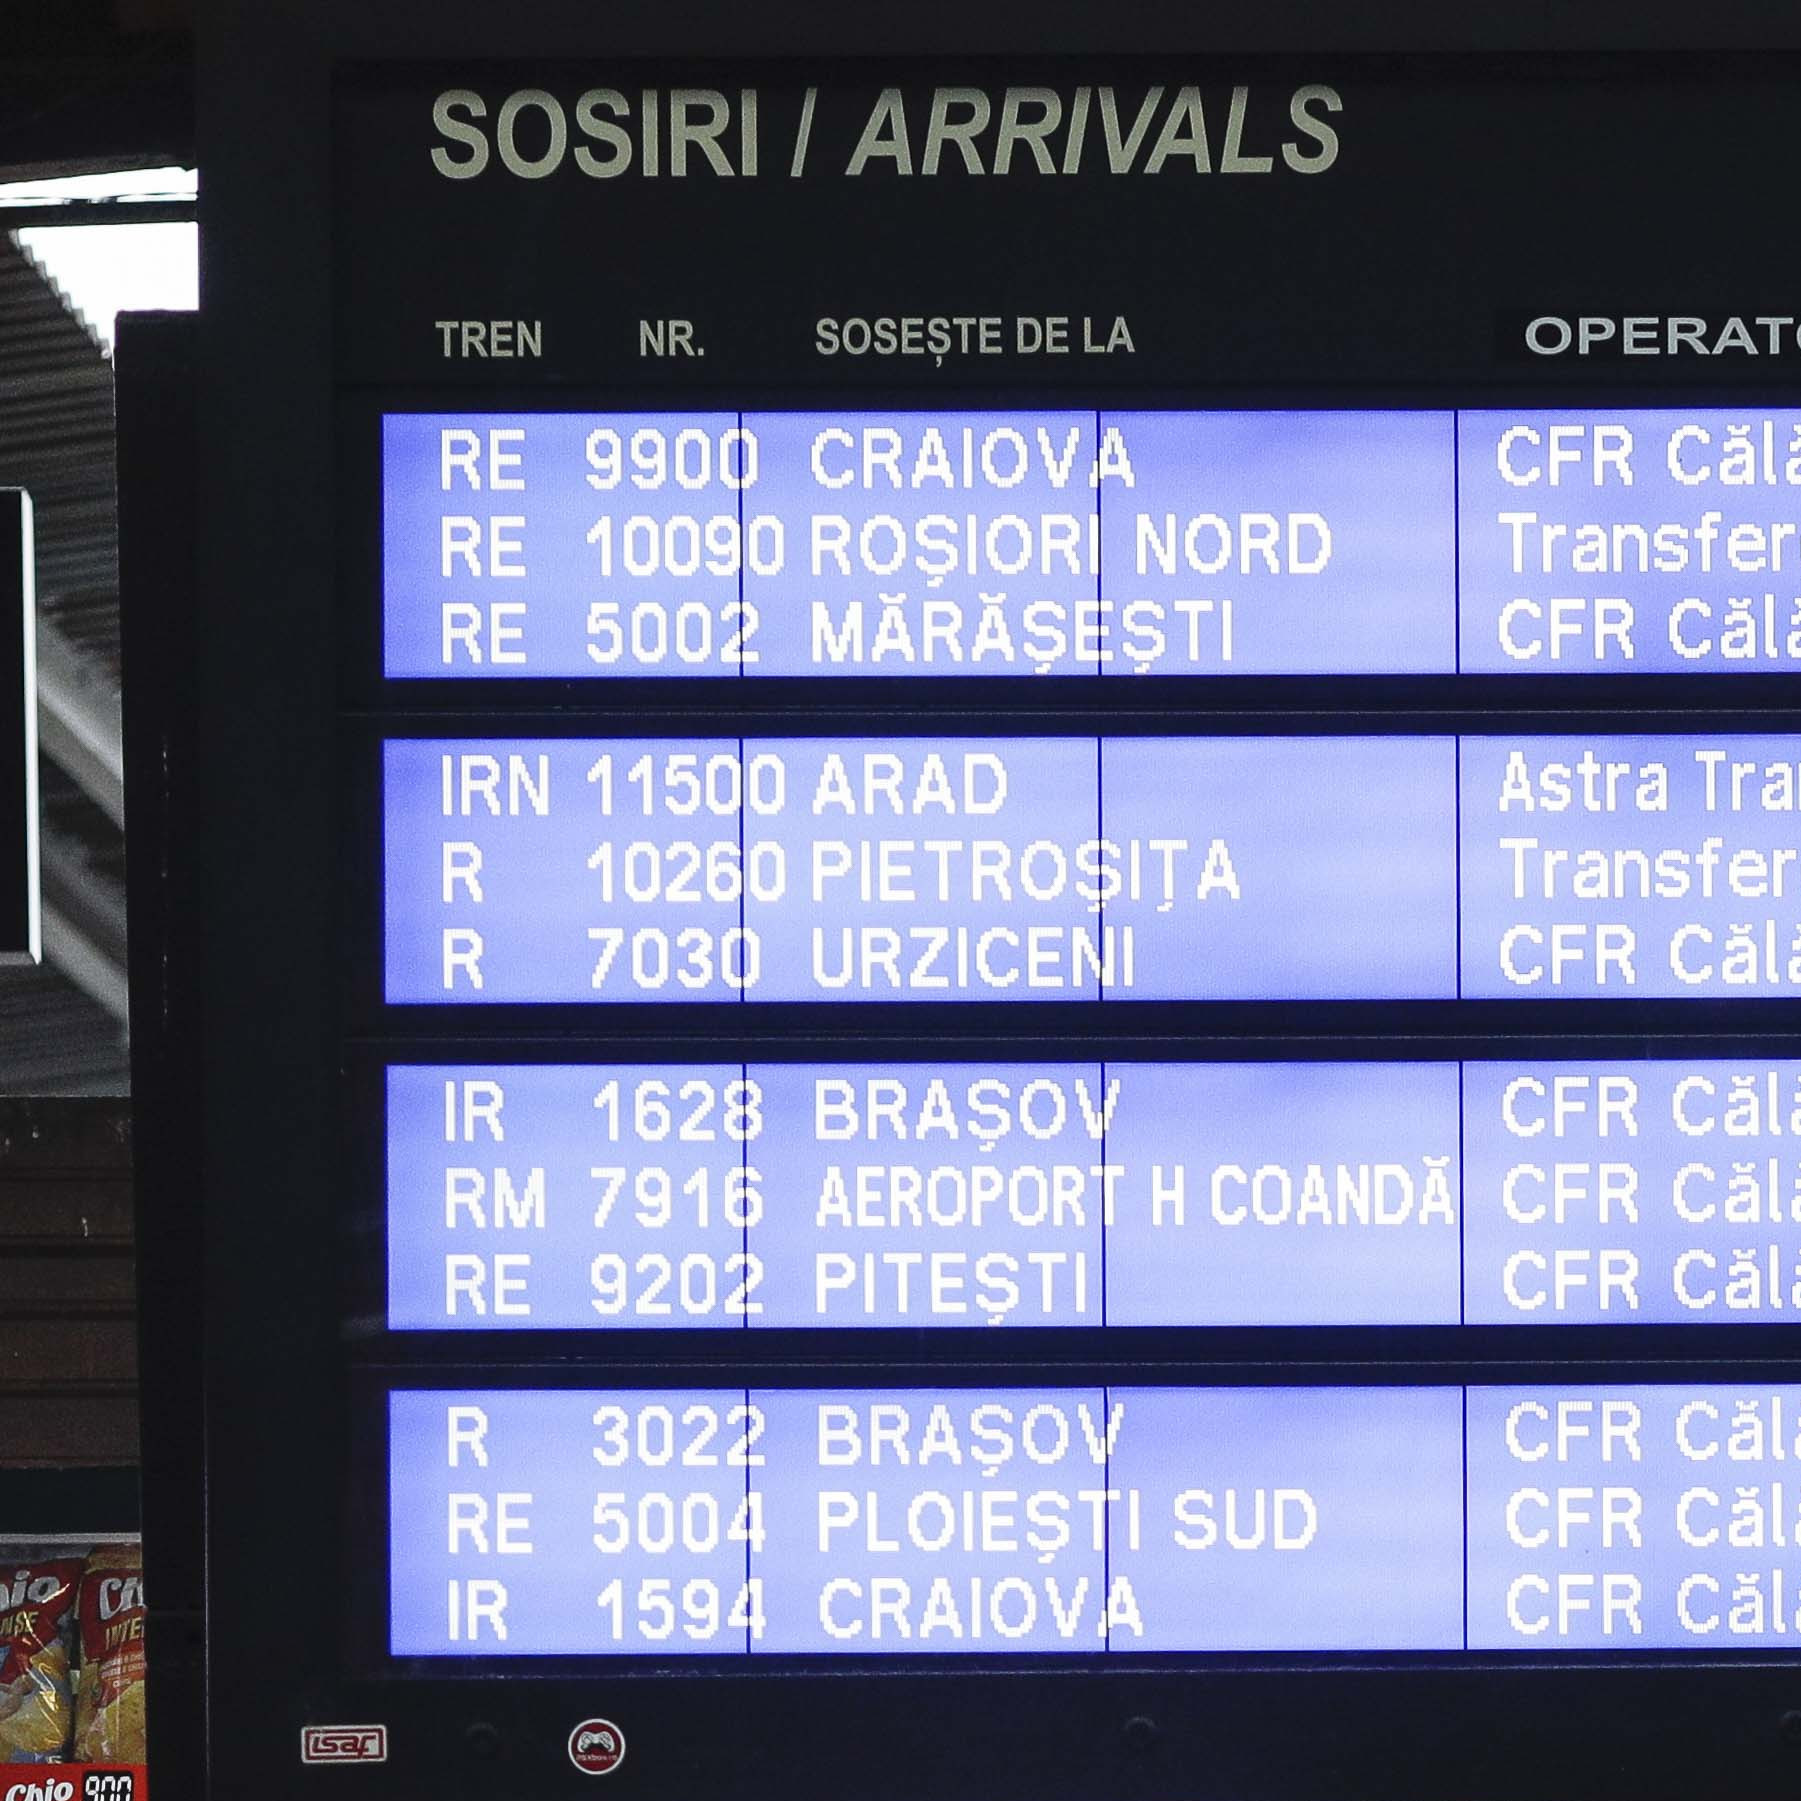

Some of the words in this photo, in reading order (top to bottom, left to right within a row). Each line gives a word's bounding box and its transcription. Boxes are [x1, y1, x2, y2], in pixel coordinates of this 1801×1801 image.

[431, 91, 757, 179] SOSIRI
[791, 90, 816, 177] /
[845, 88, 1343, 175] ARRIVALS
[435, 321, 541, 357] TREN
[639, 320, 705, 357] NR.
[816, 317, 1002, 367] SOSEȘTE
[1017, 317, 1069, 354] DE
[1084, 316, 1135, 353] LA
[442, 430, 524, 489] RE
[587, 429, 757, 489] 9900
[812, 428, 1134, 488] CRAIOVA
[1498, 426, 1632, 485] CFR
[443, 517, 525, 576] RE
[587, 516, 783, 576] 10090
[812, 515, 1098, 587] ROȘIORI
[1137, 514, 1331, 573] NORD
[443, 604, 525, 662] RE
[588, 602, 758, 662] 5002
[813, 593, 1231, 673] MĂRĂȘEȘTI
[443, 756, 548, 814] IRN
[588, 755, 784, 814] 11500
[813, 754, 1006, 814] ARAD
[1500, 752, 1666, 811] Astra
[444, 843, 482, 901] R
[588, 842, 785, 901] 10260
[813, 840, 1239, 912] PIETROȘIȚA
[446, 1082, 503, 1140] IR
[595, 1080, 761, 1140] 1628
[816, 1080, 1119, 1151] BRAȘOV
[447, 1168, 544, 1227] RM
[591, 1167, 762, 1227] 7916
[817, 1166, 1124, 1226] AEROPORT
[1153, 1166, 1184, 1225] H
[1212, 1156, 1454, 1225] COANDĂ
[1503, 1164, 1638, 1223] CFR
[449, 1407, 487, 1466] R
[594, 1406, 764, 1466] 3022
[819, 1404, 1123, 1476] BRAȘOV
[450, 1580, 506, 1639] IR
[598, 1579, 765, 1639] 1594
[820, 1577, 1142, 1638] CRAIOVA
